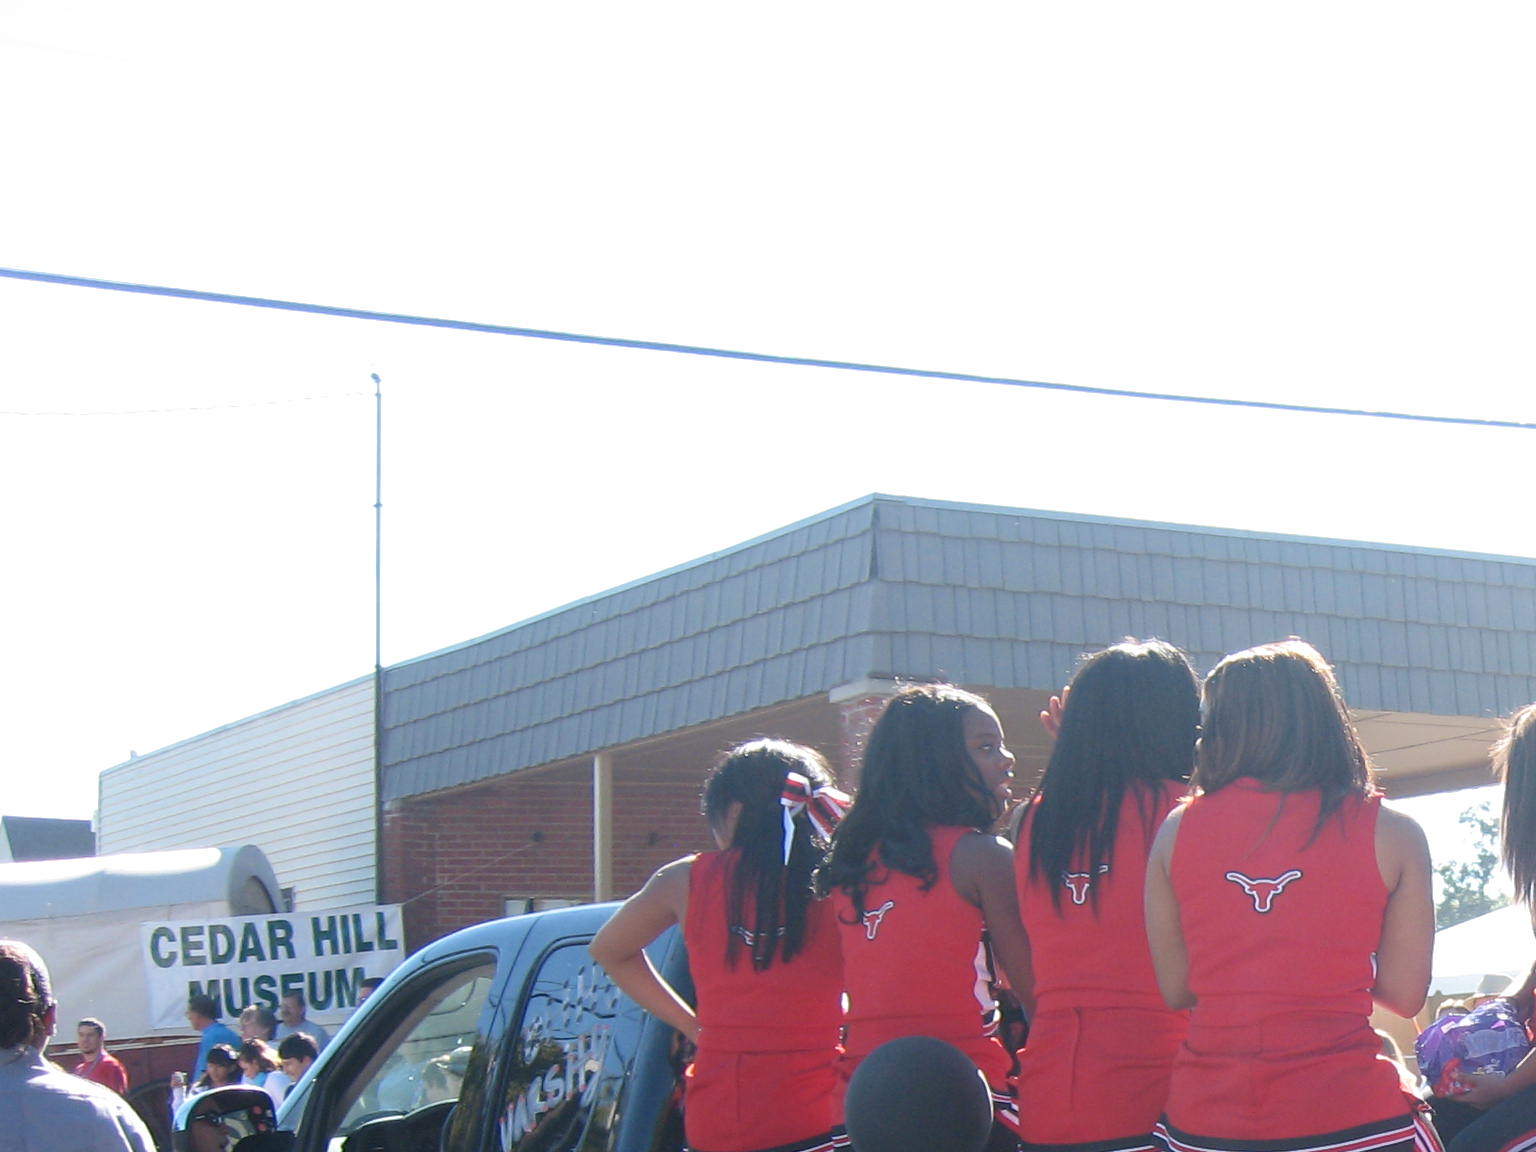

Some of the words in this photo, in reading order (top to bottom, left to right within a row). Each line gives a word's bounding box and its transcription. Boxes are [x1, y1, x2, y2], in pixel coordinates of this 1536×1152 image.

[150, 919, 296, 969] CEDAR
[310, 911, 398, 957] HILL
[188, 967, 366, 1019] MUSEUM
